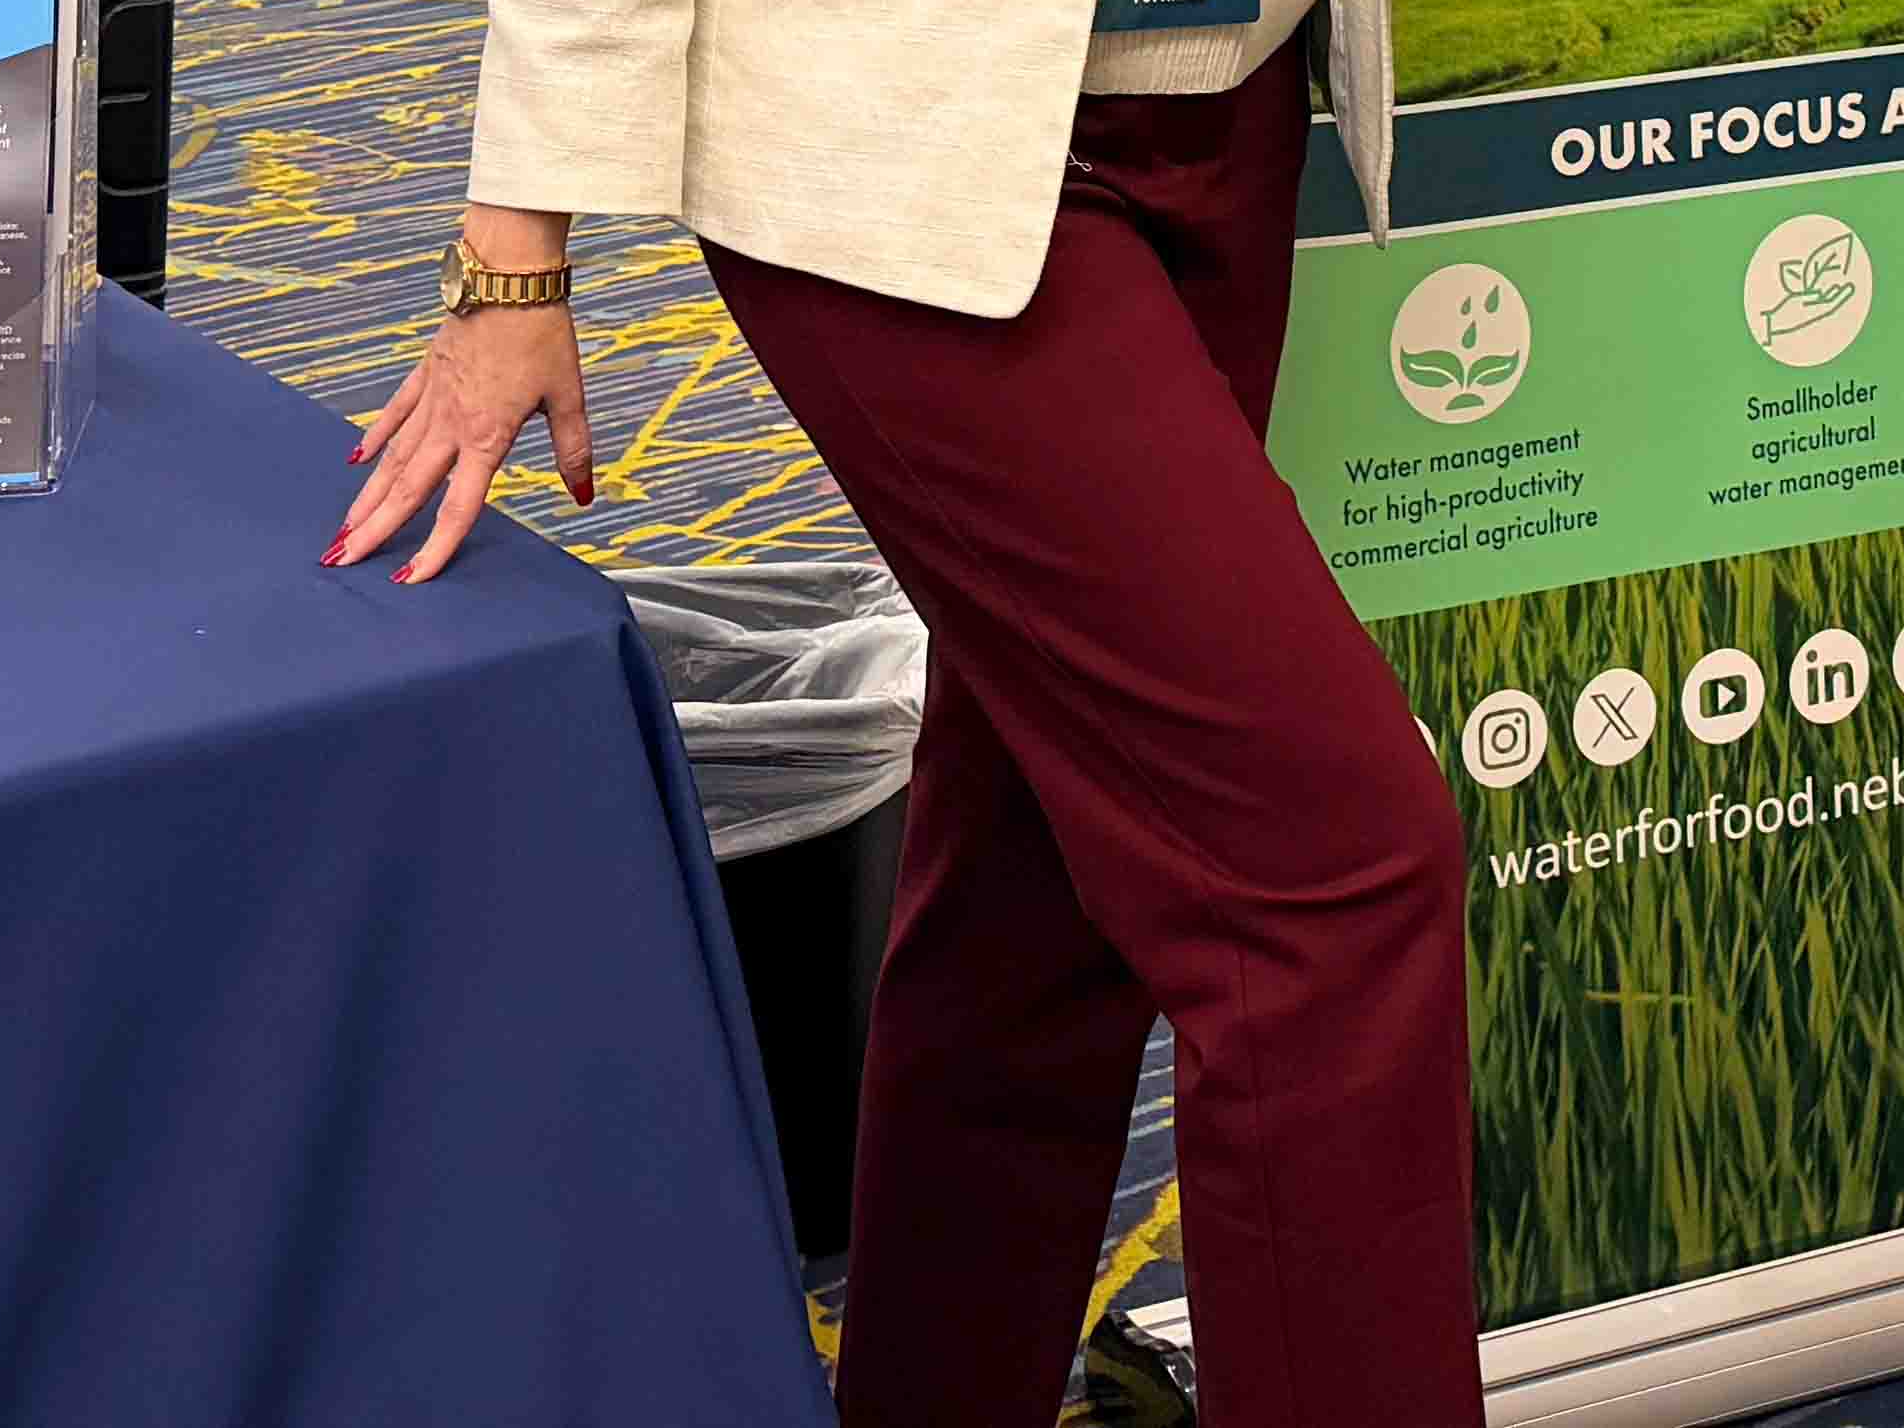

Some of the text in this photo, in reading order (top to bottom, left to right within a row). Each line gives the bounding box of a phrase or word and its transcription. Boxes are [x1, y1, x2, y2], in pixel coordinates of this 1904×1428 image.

[1551, 119, 1675, 176] OUR
[1689, 92, 1868, 161] FOCUS
[1746, 378, 1878, 422] Smallholder
[1345, 429, 1581, 486] Water management
[1751, 417, 1876, 464] agricultural
[1343, 465, 1584, 527] for high-productivity
[1708, 476, 1772, 508] water
[1330, 505, 1599, 570] commercial agriculture
